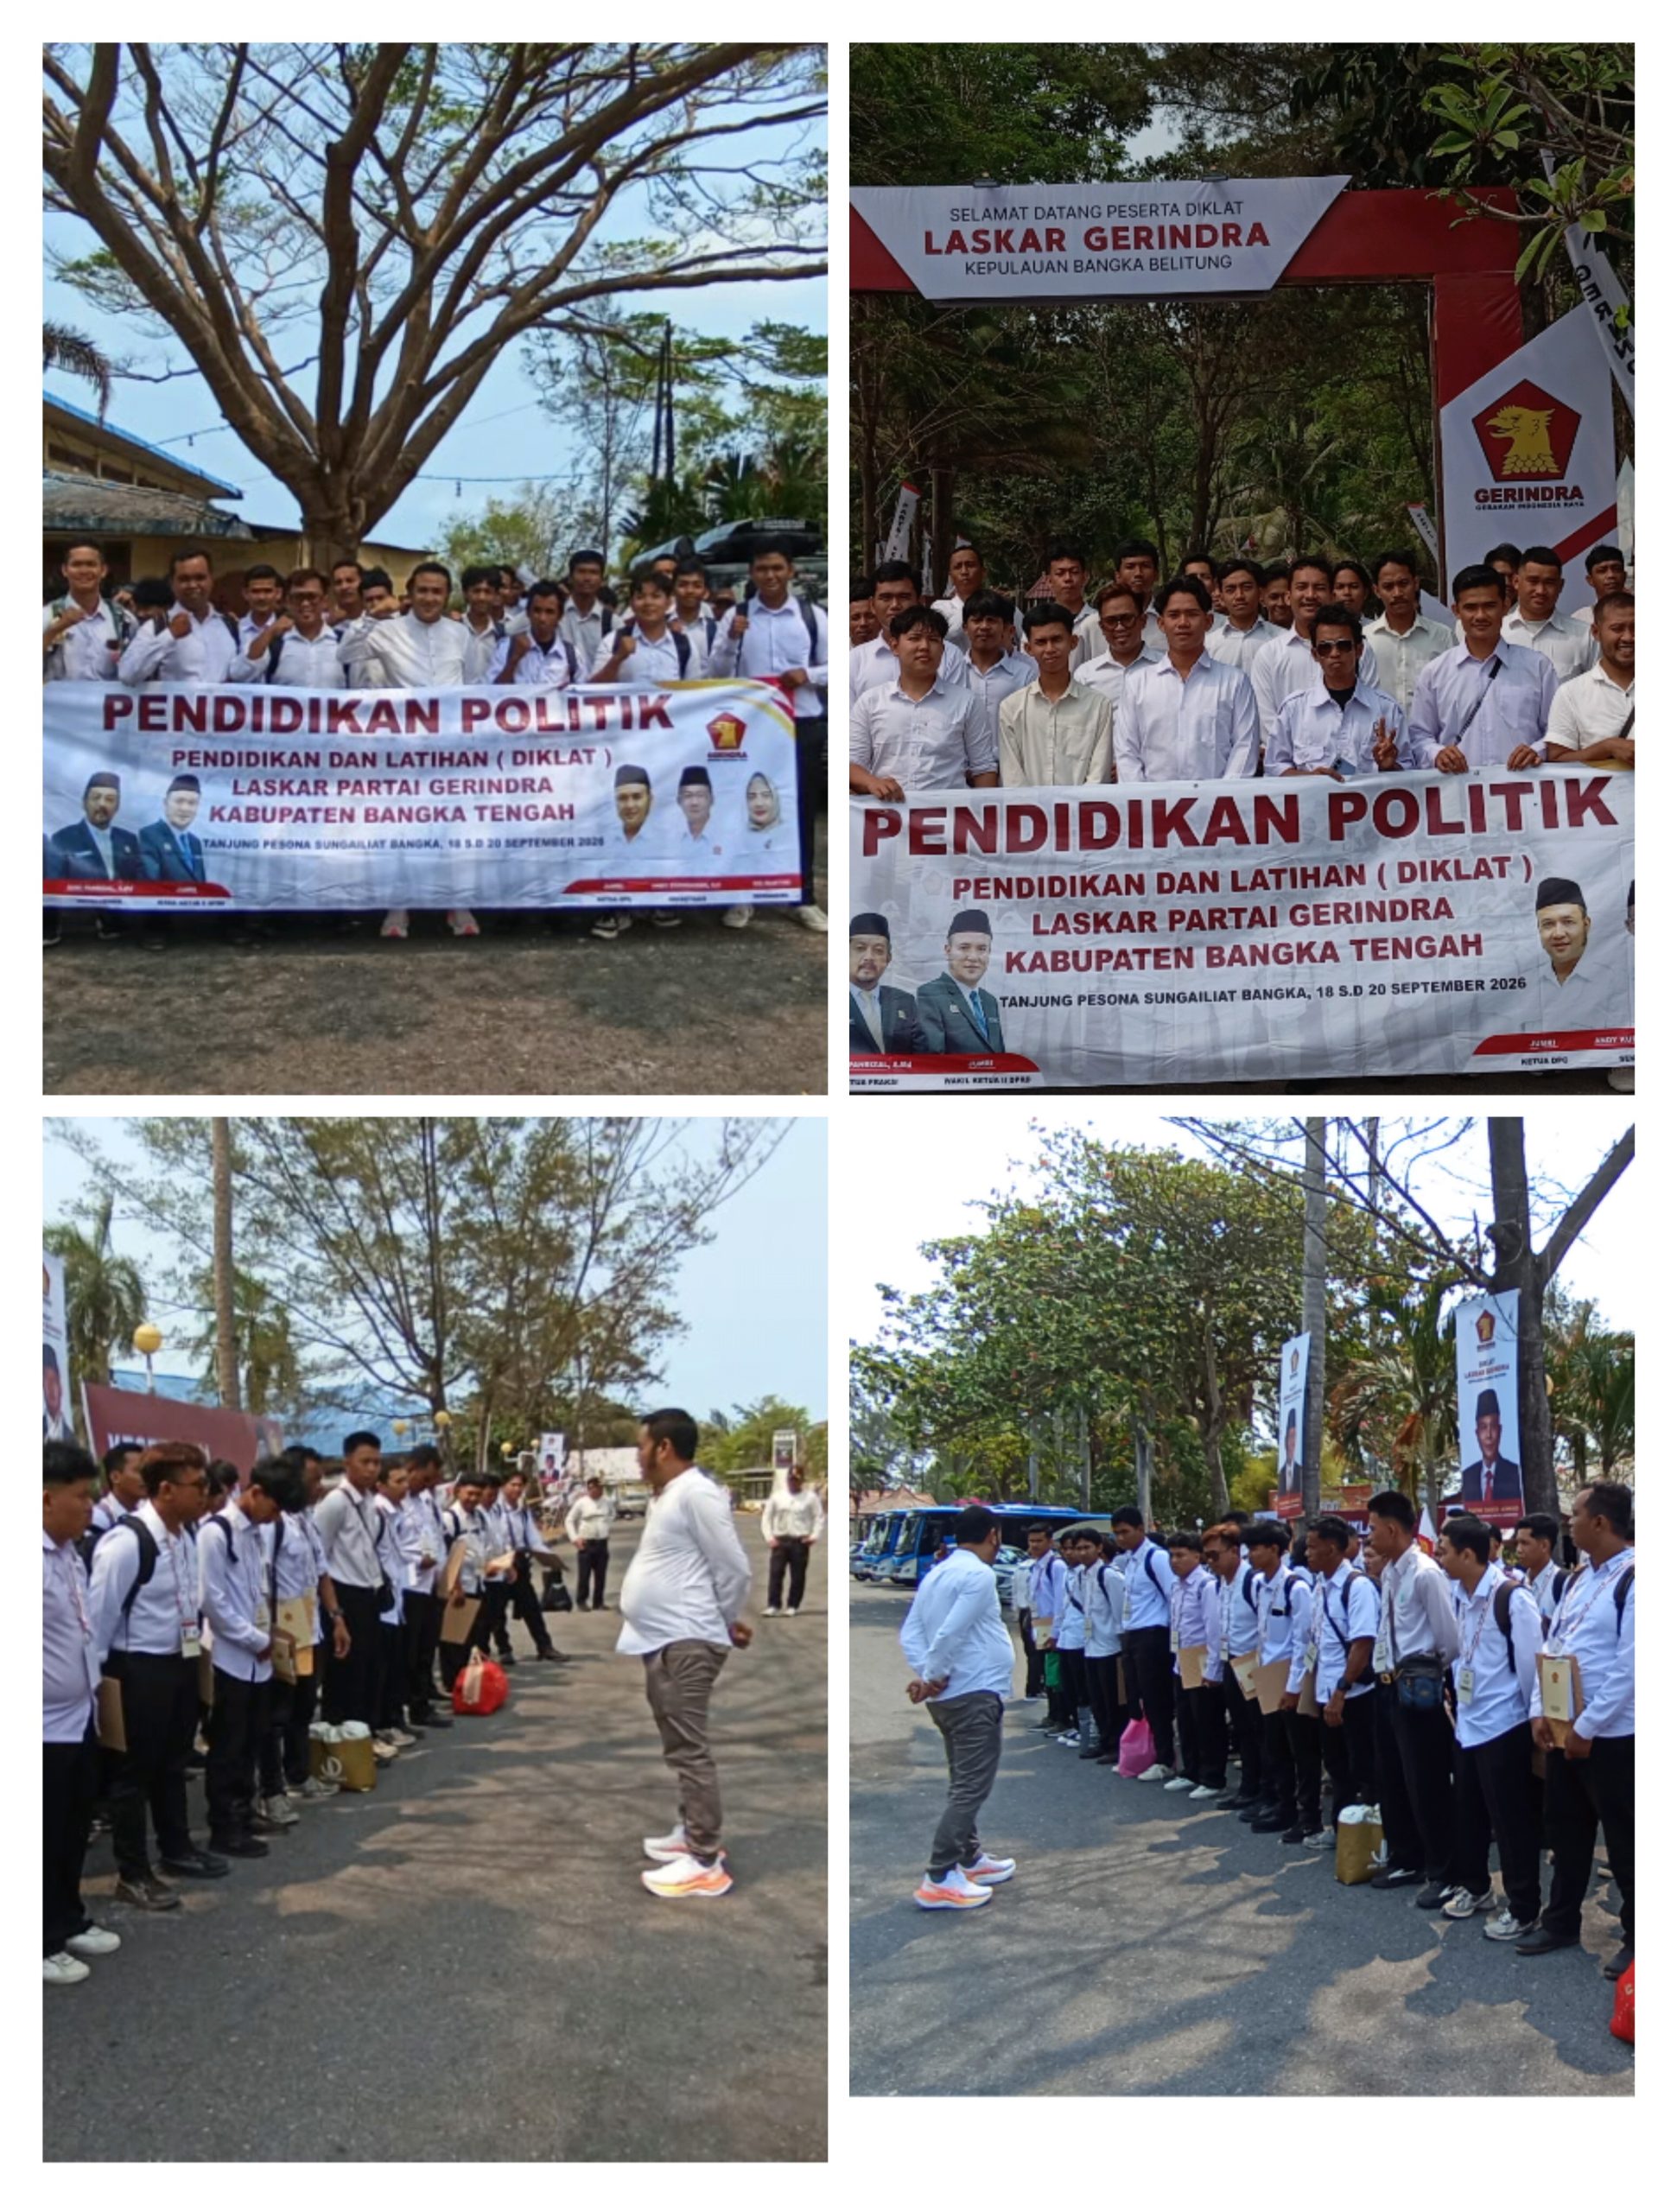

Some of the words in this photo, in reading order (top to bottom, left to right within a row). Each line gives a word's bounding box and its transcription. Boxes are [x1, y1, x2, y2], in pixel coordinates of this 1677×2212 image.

[950, 207, 1029, 222] SELAMAT
[1033, 204, 1102, 220] DATANG
[1107, 201, 1180, 218] PESERTA
[1185, 200, 1243, 215] DIKLAT
[924, 226, 1067, 257] LASKAR
[1083, 221, 1270, 252] GERINDRA
[965, 258, 1069, 275] KEPULAUAN
[1073, 257, 1144, 274] BANGKA
[1149, 254, 1233, 271] BELITUNG
[1474, 486, 1585, 503] GERINDRA
[102, 694, 440, 734] PENDIDIKAN
[461, 693, 675, 734] POLITIK
[172, 750, 321, 768] PENDIDIKAN
[327, 751, 380, 769] DAN
[385, 749, 489, 769] LATIHAN
[511, 747, 596, 766] DIKLAT
[232, 779, 328, 797] LASKAR
[336, 779, 420, 797] PARTAI
[429, 777, 554, 795] GERINDRA
[209, 804, 355, 824] KABUPATEN
[363, 804, 467, 823] BANGKA
[475, 803, 575, 823] TENGAH
[862, 793, 1300, 857] PENDIDIKAN
[1328, 776, 1619, 842] POLITIK
[202, 838, 259, 849] TANJUNG
[263, 839, 311, 850] PESONA
[314, 839, 386, 850] SUNGAILIAT
[486, 838, 501, 849] 20
[505, 836, 575, 849] SEPTEMBER
[952, 873, 1146, 900] PENDIDIKAN
[1155, 870, 1220, 895] DAN
[1229, 863, 1366, 893] LATIHAN
[1377, 861, 1388, 891] (
[1396, 855, 1512, 885] DIKLAT
[1522, 854, 1533, 883] )
[1032, 910, 1158, 937] LASKAR
[1168, 906, 1278, 932] PARTAI
[1288, 896, 1455, 927] GERINDRA
[1004, 946, 1194, 974] KABUPATEN
[1205, 939, 1341, 969] BANGKA
[1349, 933, 1483, 962] TENGAH
[999, 995, 1073, 1008] TANJUNG
[1077, 993, 1140, 1007] PESONA
[1144, 990, 1236, 1005] SUNGAILIAT
[1242, 987, 1312, 1001] BANGKA,
[1316, 985, 1334, 998] 18
[1338, 984, 1364, 997] S.D
[1368, 982, 1387, 996] 20
[1391, 979, 1485, 995] SEPTEMBER
[1490, 976, 1528, 990] 2026
